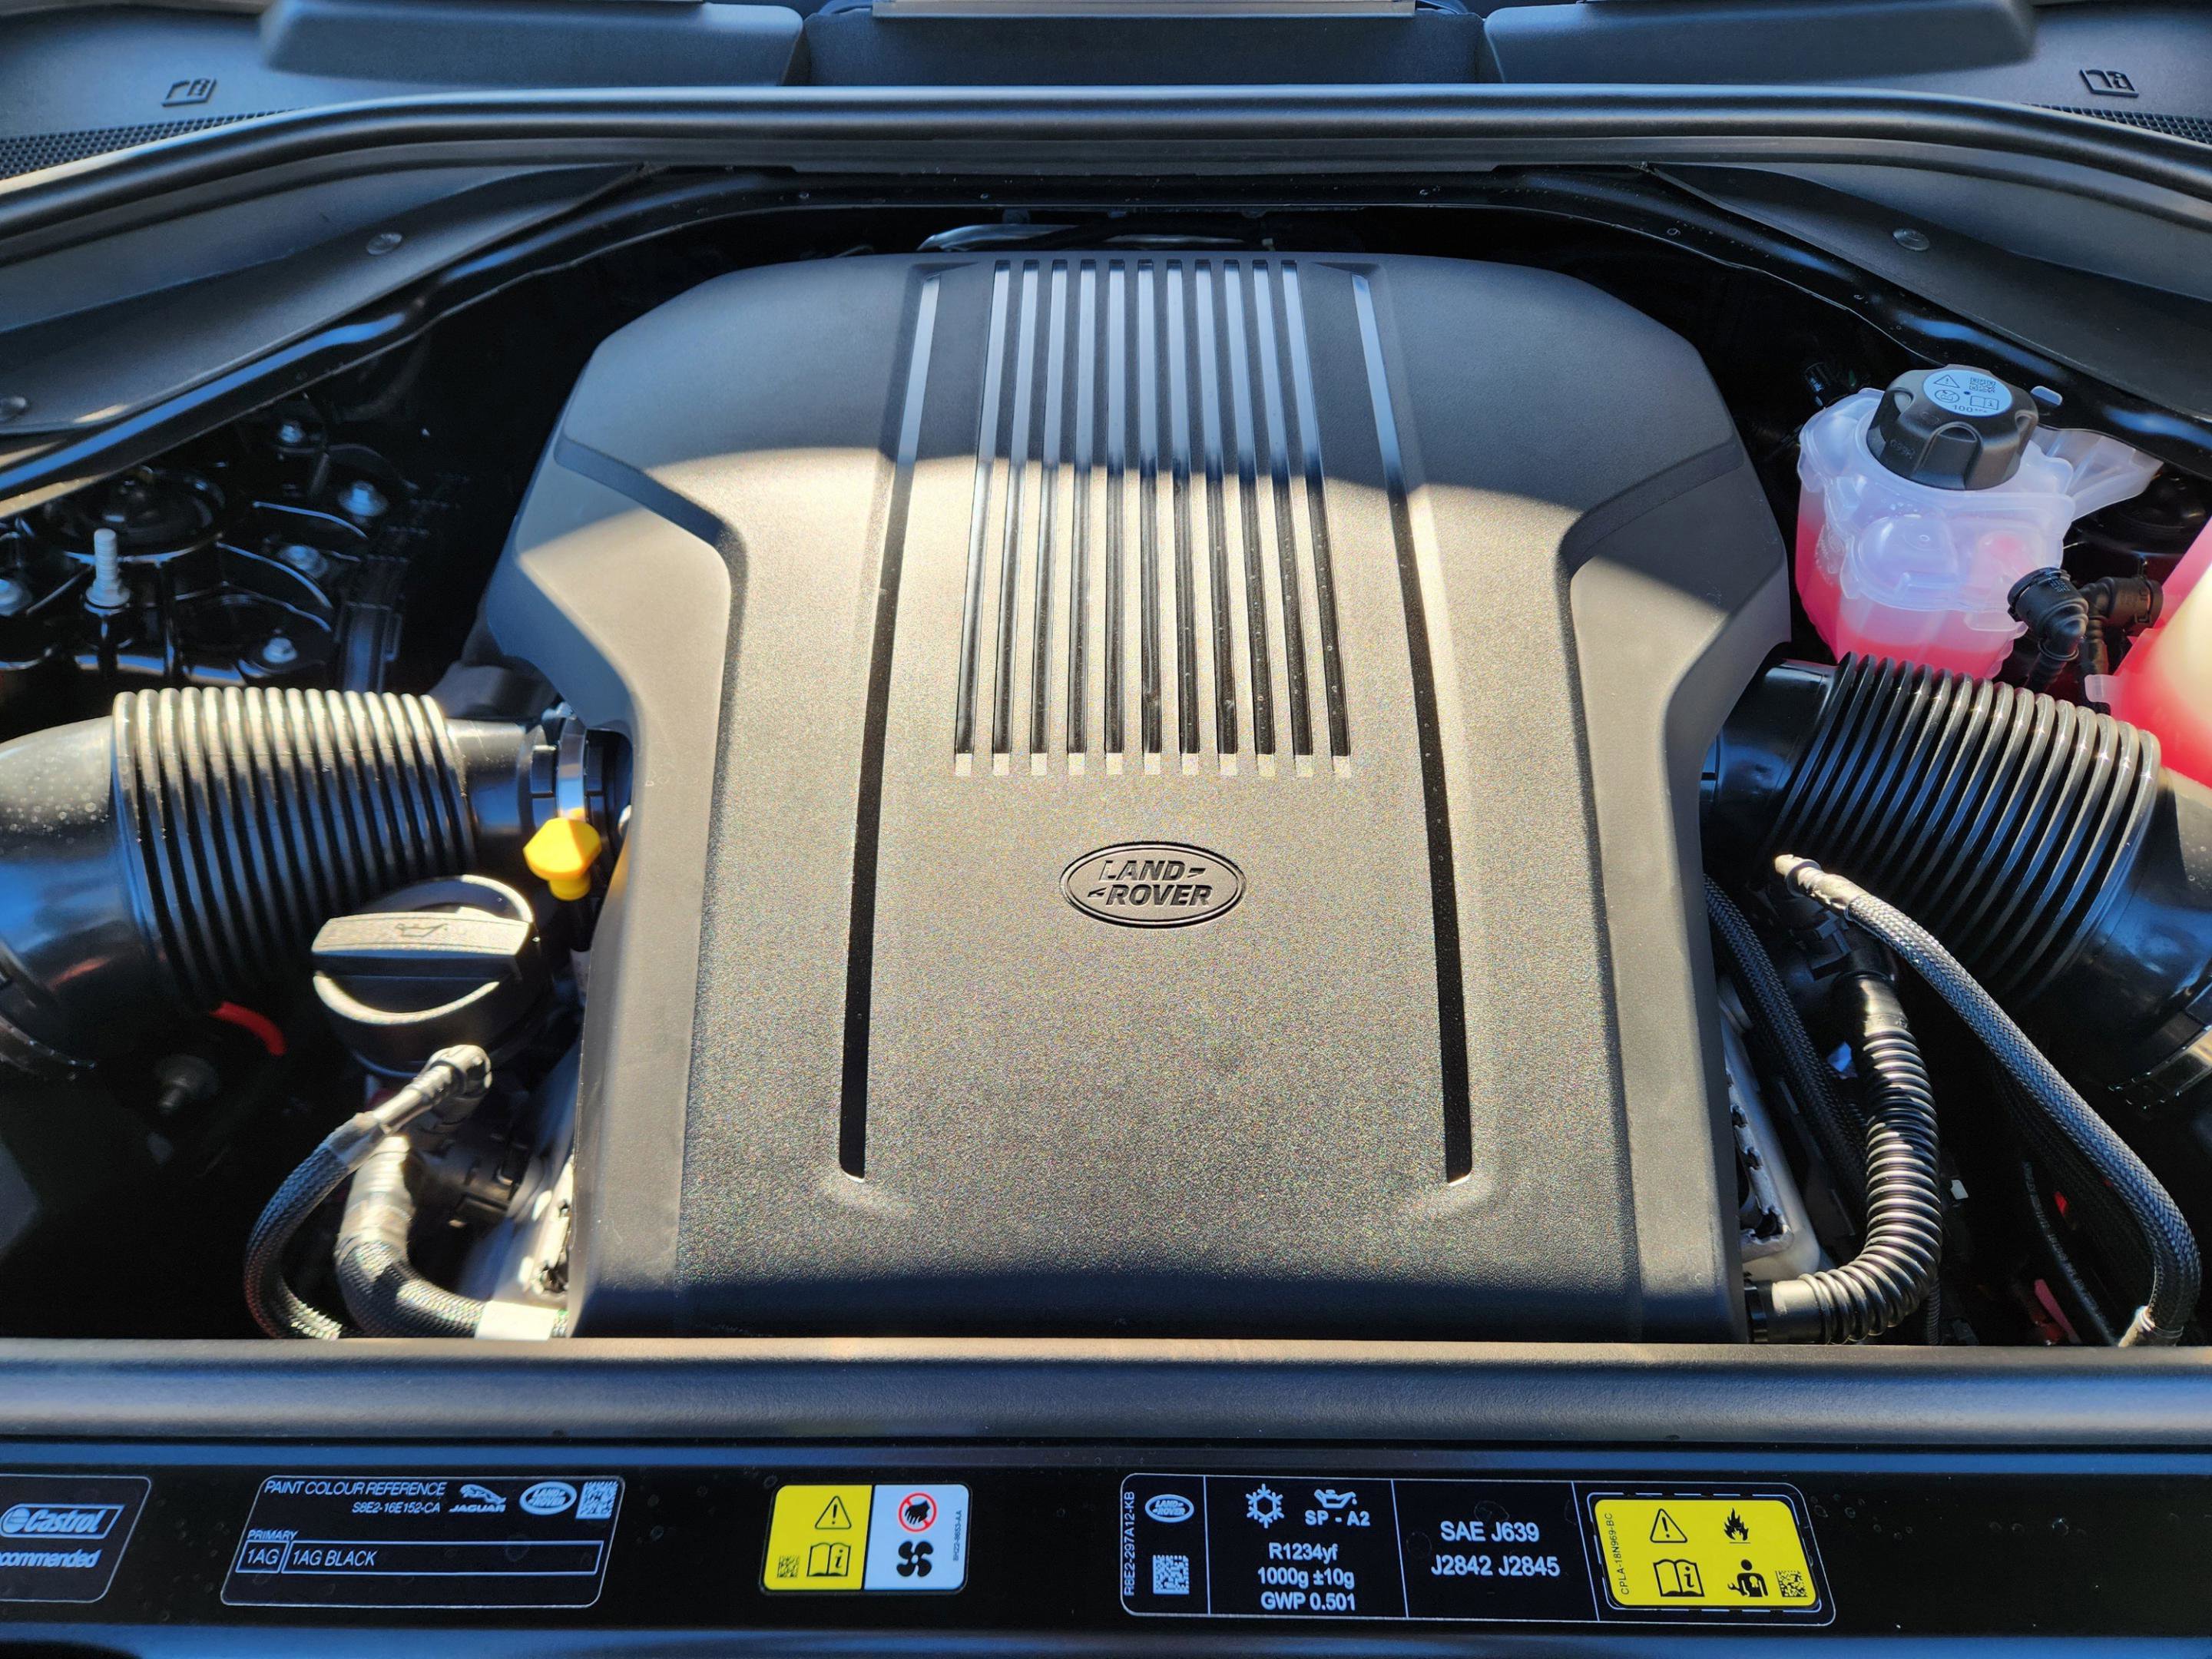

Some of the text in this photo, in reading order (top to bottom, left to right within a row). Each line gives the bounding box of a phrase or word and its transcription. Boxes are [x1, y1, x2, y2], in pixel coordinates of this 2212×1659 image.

[1098, 859, 1186, 882] LAND
[1104, 884, 1214, 906] ROVER
[264, 1480, 448, 1496] PAINT COLOUR REFERENCE
[449, 1504, 506, 1513] JAGUAR
[1304, 1509, 1329, 1526] SP
[1346, 1510, 1371, 1527] A2
[24, 1508, 108, 1534] Castrol
[247, 1529, 299, 1540] PRIMARY
[1440, 1521, 1541, 1543] SAE J639
[0, 1548, 102, 1568] commended
[247, 1548, 280, 1565] 1AG
[293, 1548, 378, 1567] 1AG BLACK
[1268, 1541, 1339, 1565] R1234yf
[1604, 1512, 1630, 1596] CPLA-18N969-BC
[1430, 1554, 1561, 1577] J2842 J2845
[1257, 1566, 1355, 1590] 1000g ±10g
[1260, 1591, 1356, 1611] GWP 0.501
